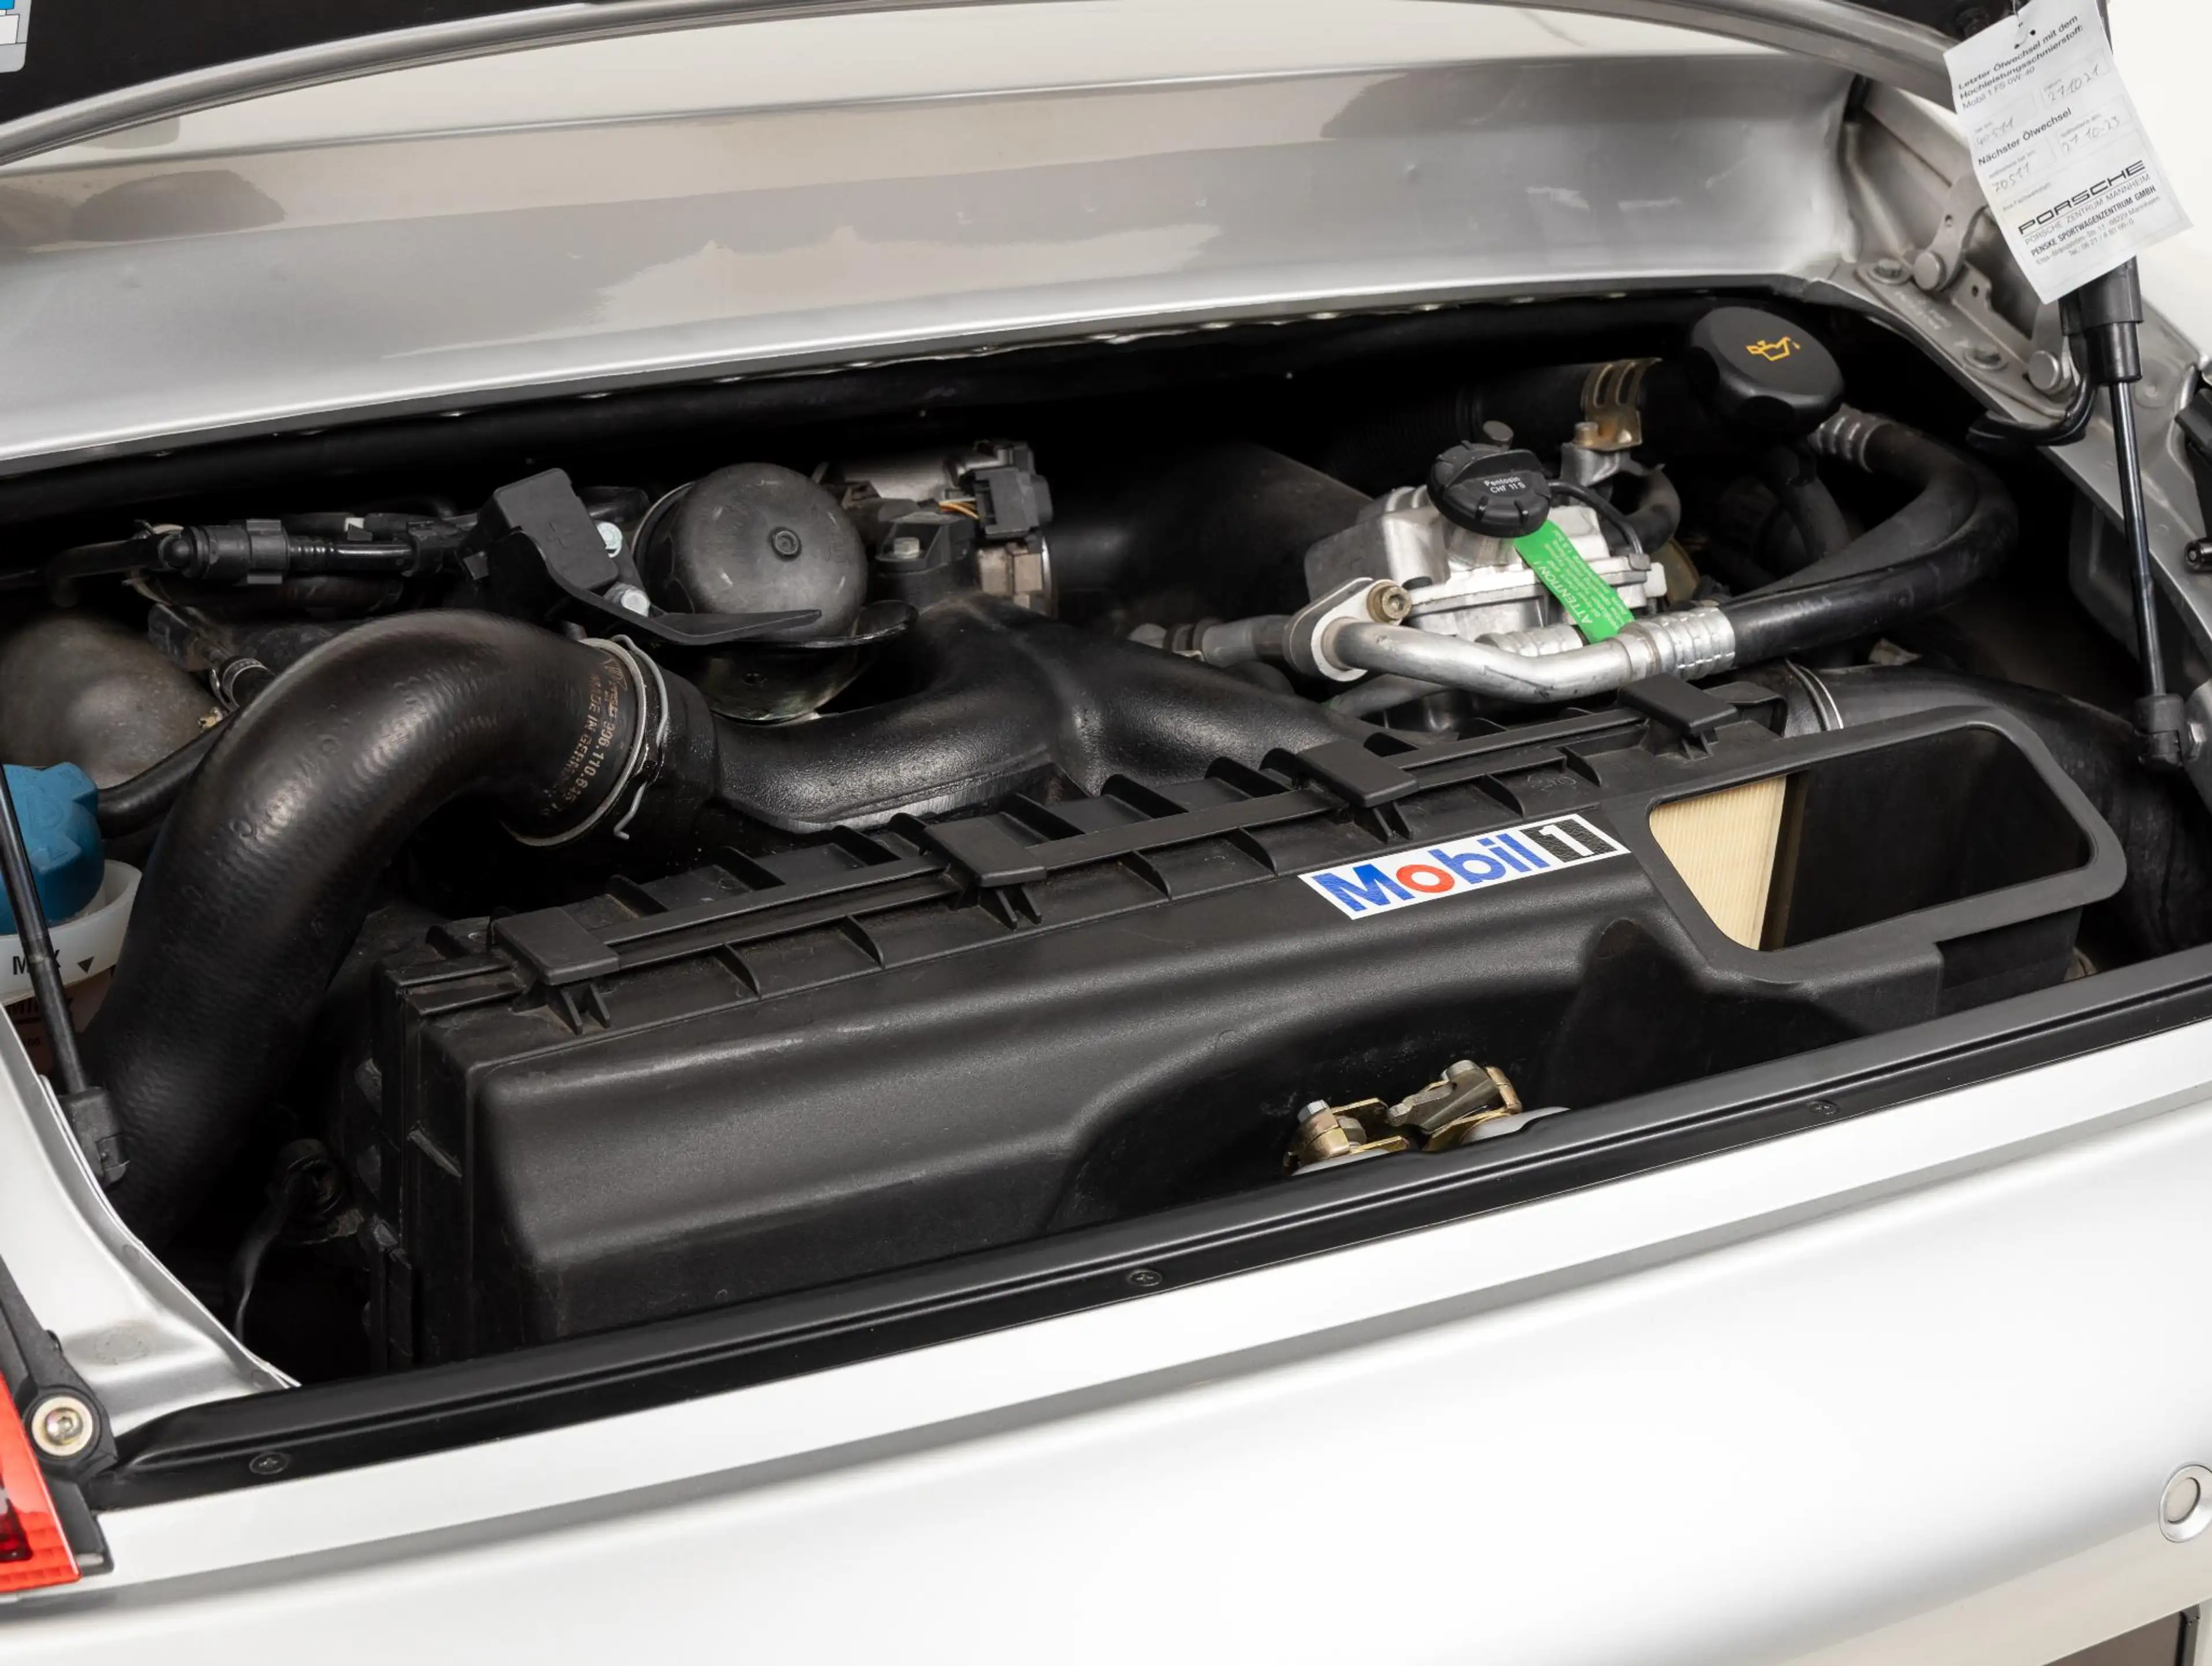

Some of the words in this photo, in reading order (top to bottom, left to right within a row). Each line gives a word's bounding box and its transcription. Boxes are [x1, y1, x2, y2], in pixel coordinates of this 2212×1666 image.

[1958, 70, 1992, 90] Letzter
[1993, 40, 2041, 71] Ölwechsel
[2043, 29, 2058, 45] mit
[2059, 16, 2078, 34] dem
[1962, 94, 1986, 109] Mobil
[1978, 138, 2021, 166] Nächster
[2023, 108, 2072, 141] Ölwechsel
[2018, 160, 2145, 234] PORSCHE
[2031, 239, 2057, 257] PENSKE
[2058, 197, 2133, 242] SPORTWAGENZENTRUM
[2135, 185, 2156, 201] GMBH
[2067, 201, 2103, 223] ZENTRUM
[2106, 174, 2150, 201] MANNHEIM
[1538, 566, 1593, 623] ATTENTION
[1312, 832, 1551, 912] Mobil
[1537, 823, 1597, 858] 1
